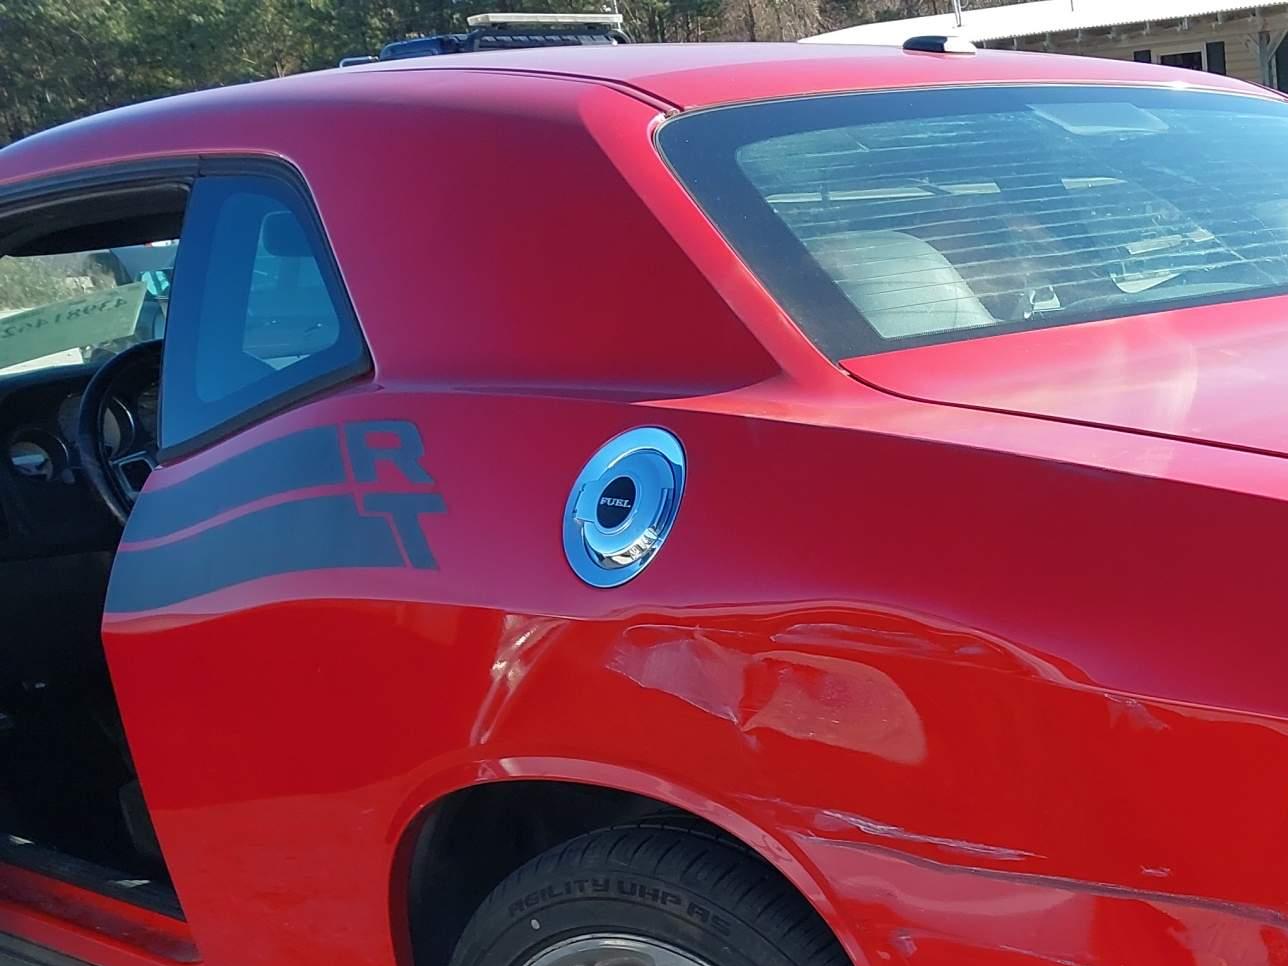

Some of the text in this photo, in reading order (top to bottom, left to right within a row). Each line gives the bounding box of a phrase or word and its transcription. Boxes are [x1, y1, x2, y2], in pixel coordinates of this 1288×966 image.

[599, 495, 632, 509] FUEL
[509, 878, 733, 936] AGILITY UHP AS
